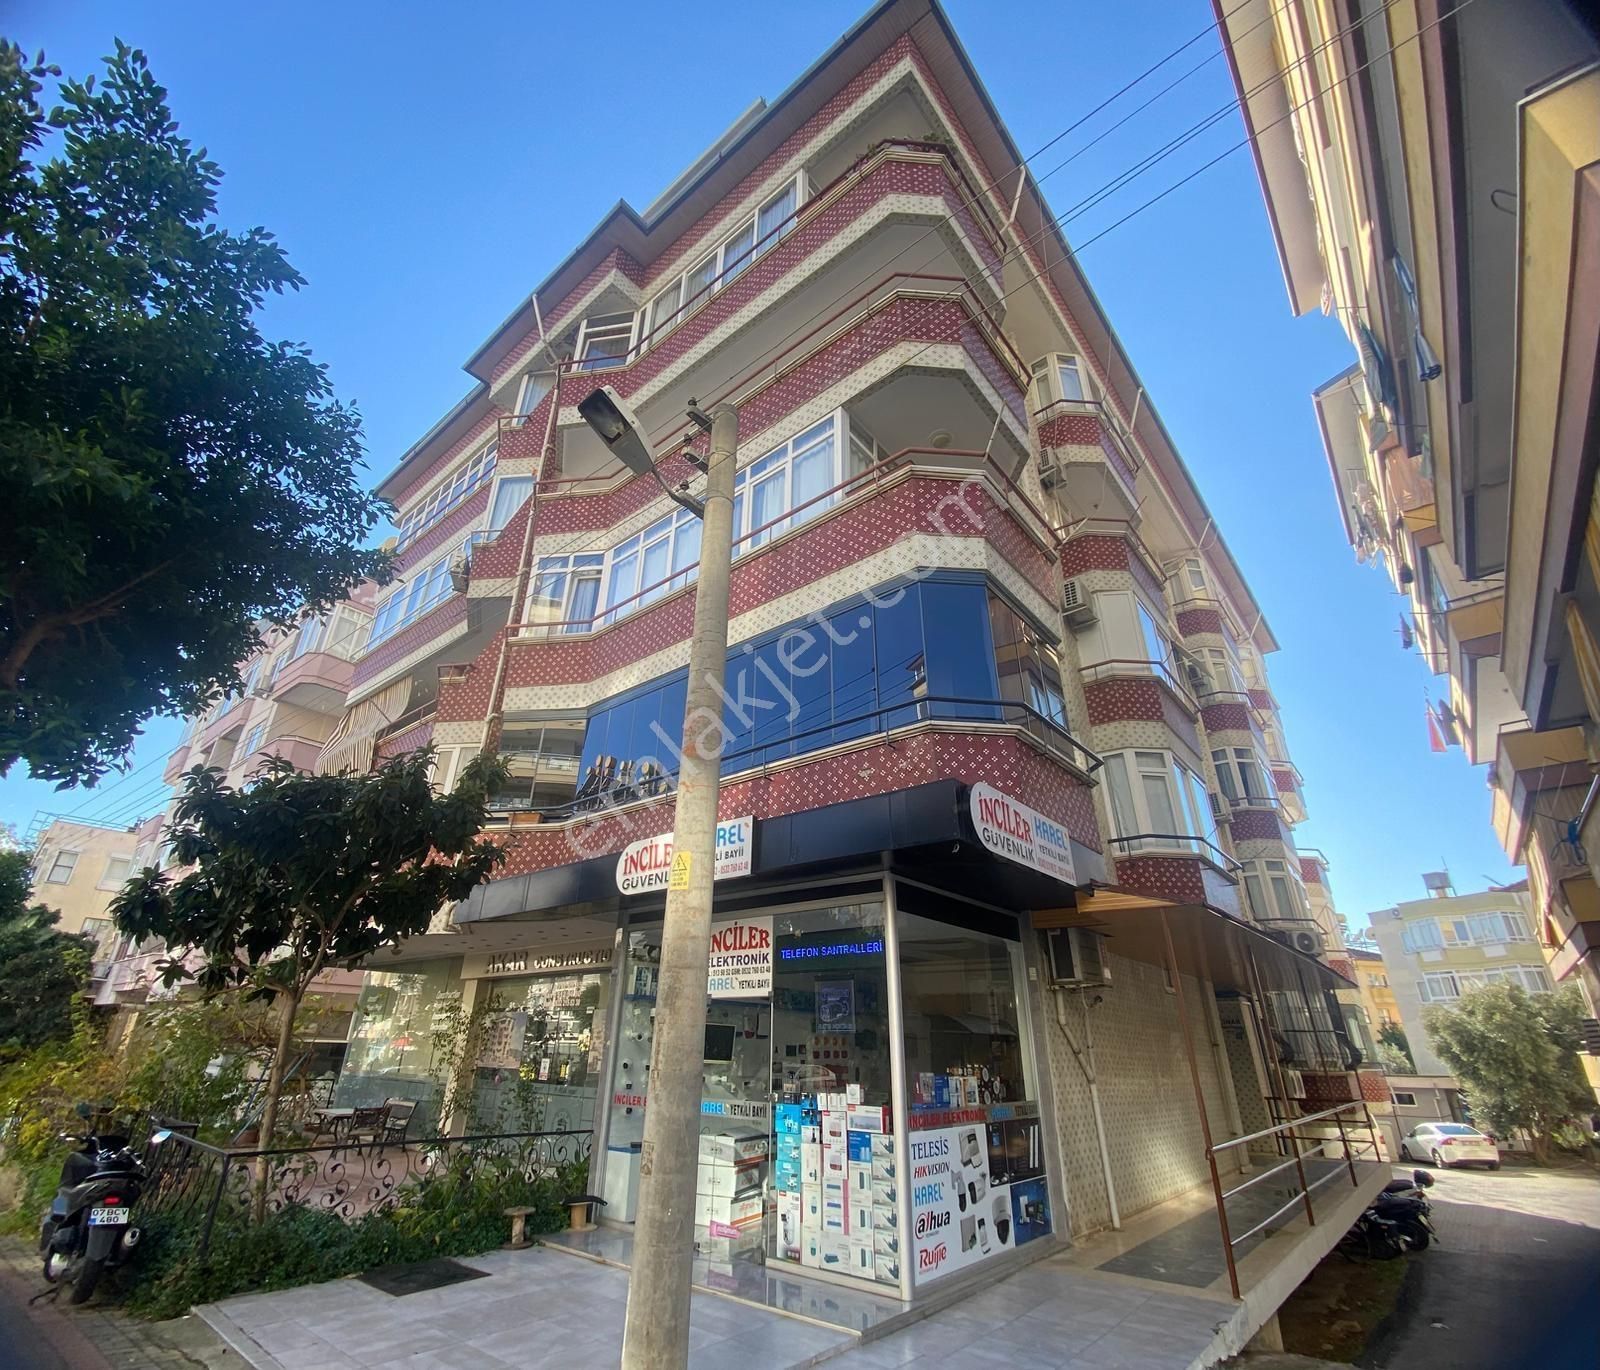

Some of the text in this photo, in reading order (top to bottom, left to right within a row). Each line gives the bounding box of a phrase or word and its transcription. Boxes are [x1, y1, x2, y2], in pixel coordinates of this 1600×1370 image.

[978, 792, 1068, 850] İNCİLER KAREL
[623, 823, 745, 876] İNCİLE REL
[982, 827, 1035, 862] GÜVENLİK
[622, 870, 669, 890] GÜVENL
[711, 921, 770, 953] NCİLER
[781, 940, 883, 959] TELEFON SANTRALLERİ
[709, 977, 736, 991] AREL
[730, 1102, 750, 1117] YETKİLİ
[751, 1103, 767, 1118] BAYİİ
[911, 1136, 949, 1160] TELESİS
[914, 1161, 951, 1179] HIKVISION
[914, 1182, 943, 1207] KAREL
[920, 1242, 947, 1270] Ruijie
